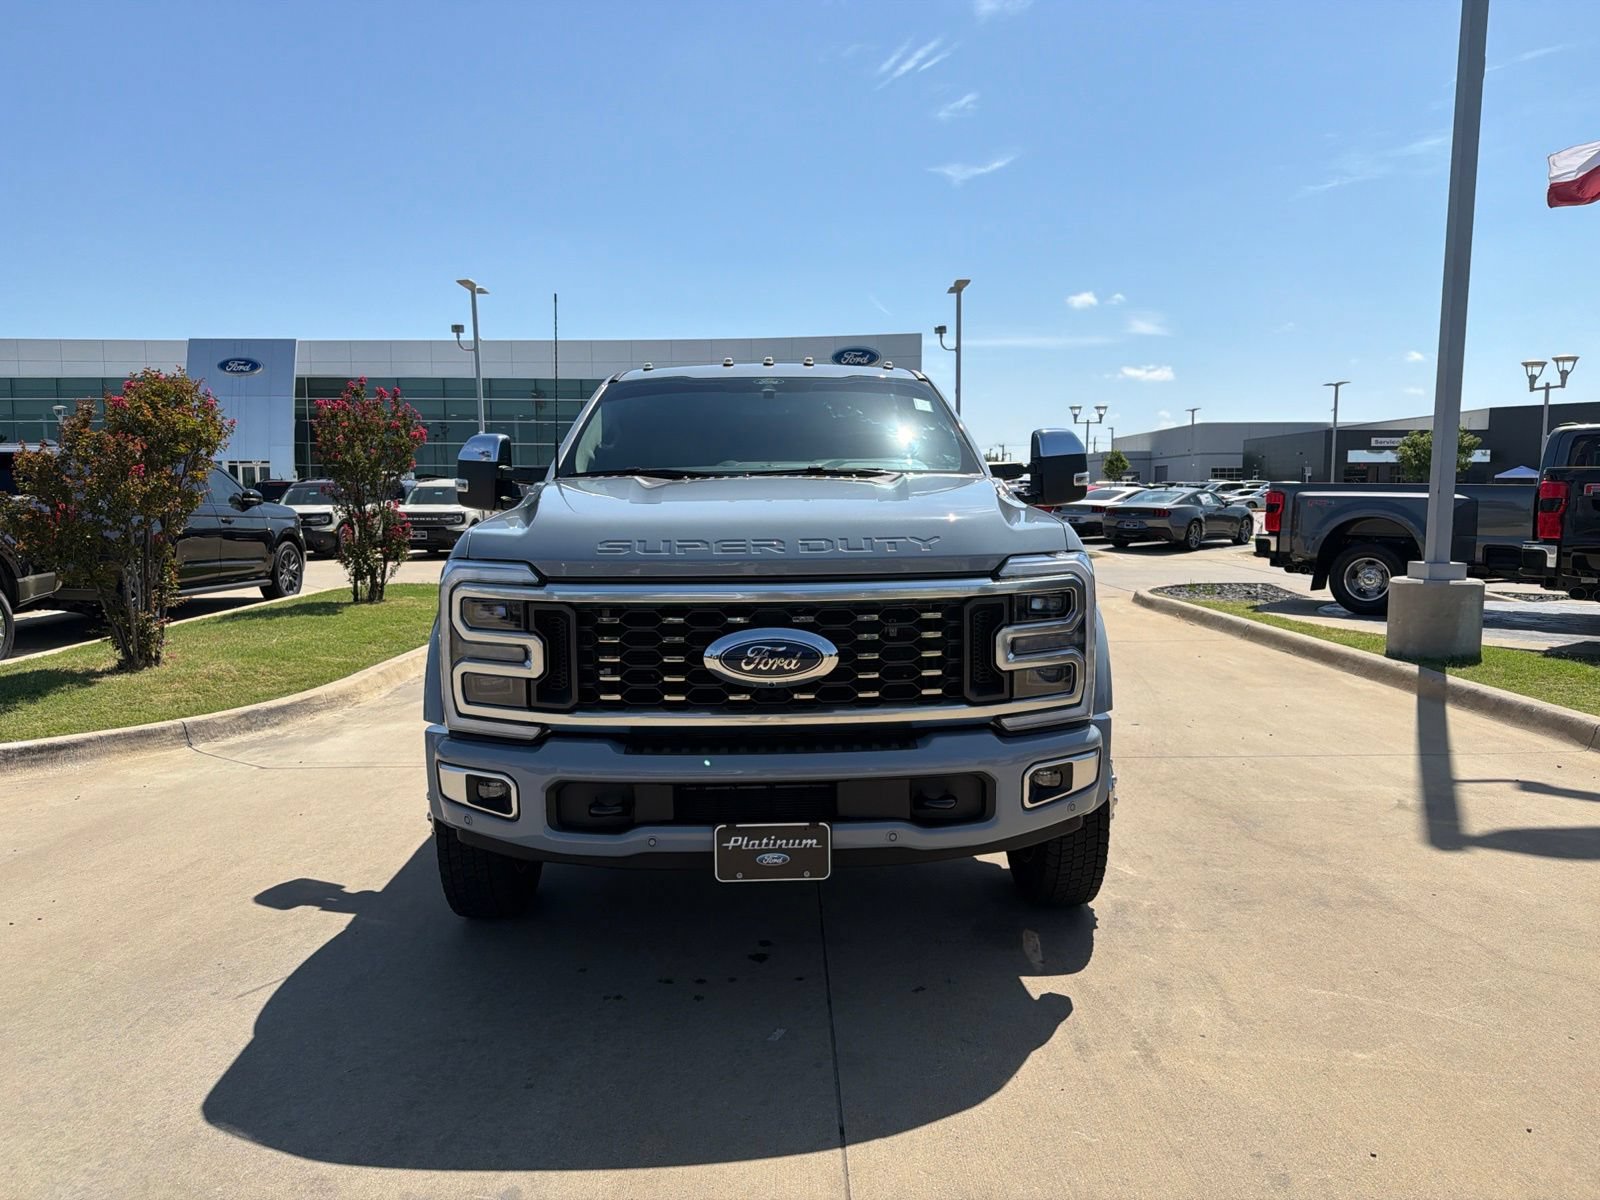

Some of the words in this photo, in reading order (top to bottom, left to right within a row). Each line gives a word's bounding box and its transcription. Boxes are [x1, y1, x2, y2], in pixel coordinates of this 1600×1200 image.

[841, 352, 869, 364] Ford
[226, 361, 251, 371] Ford
[596, 538, 786, 555] SUPER
[798, 535, 940, 554] DUTY
[741, 645, 802, 670] Ford
[722, 835, 823, 850] Platinum
[763, 855, 783, 864] Ford
